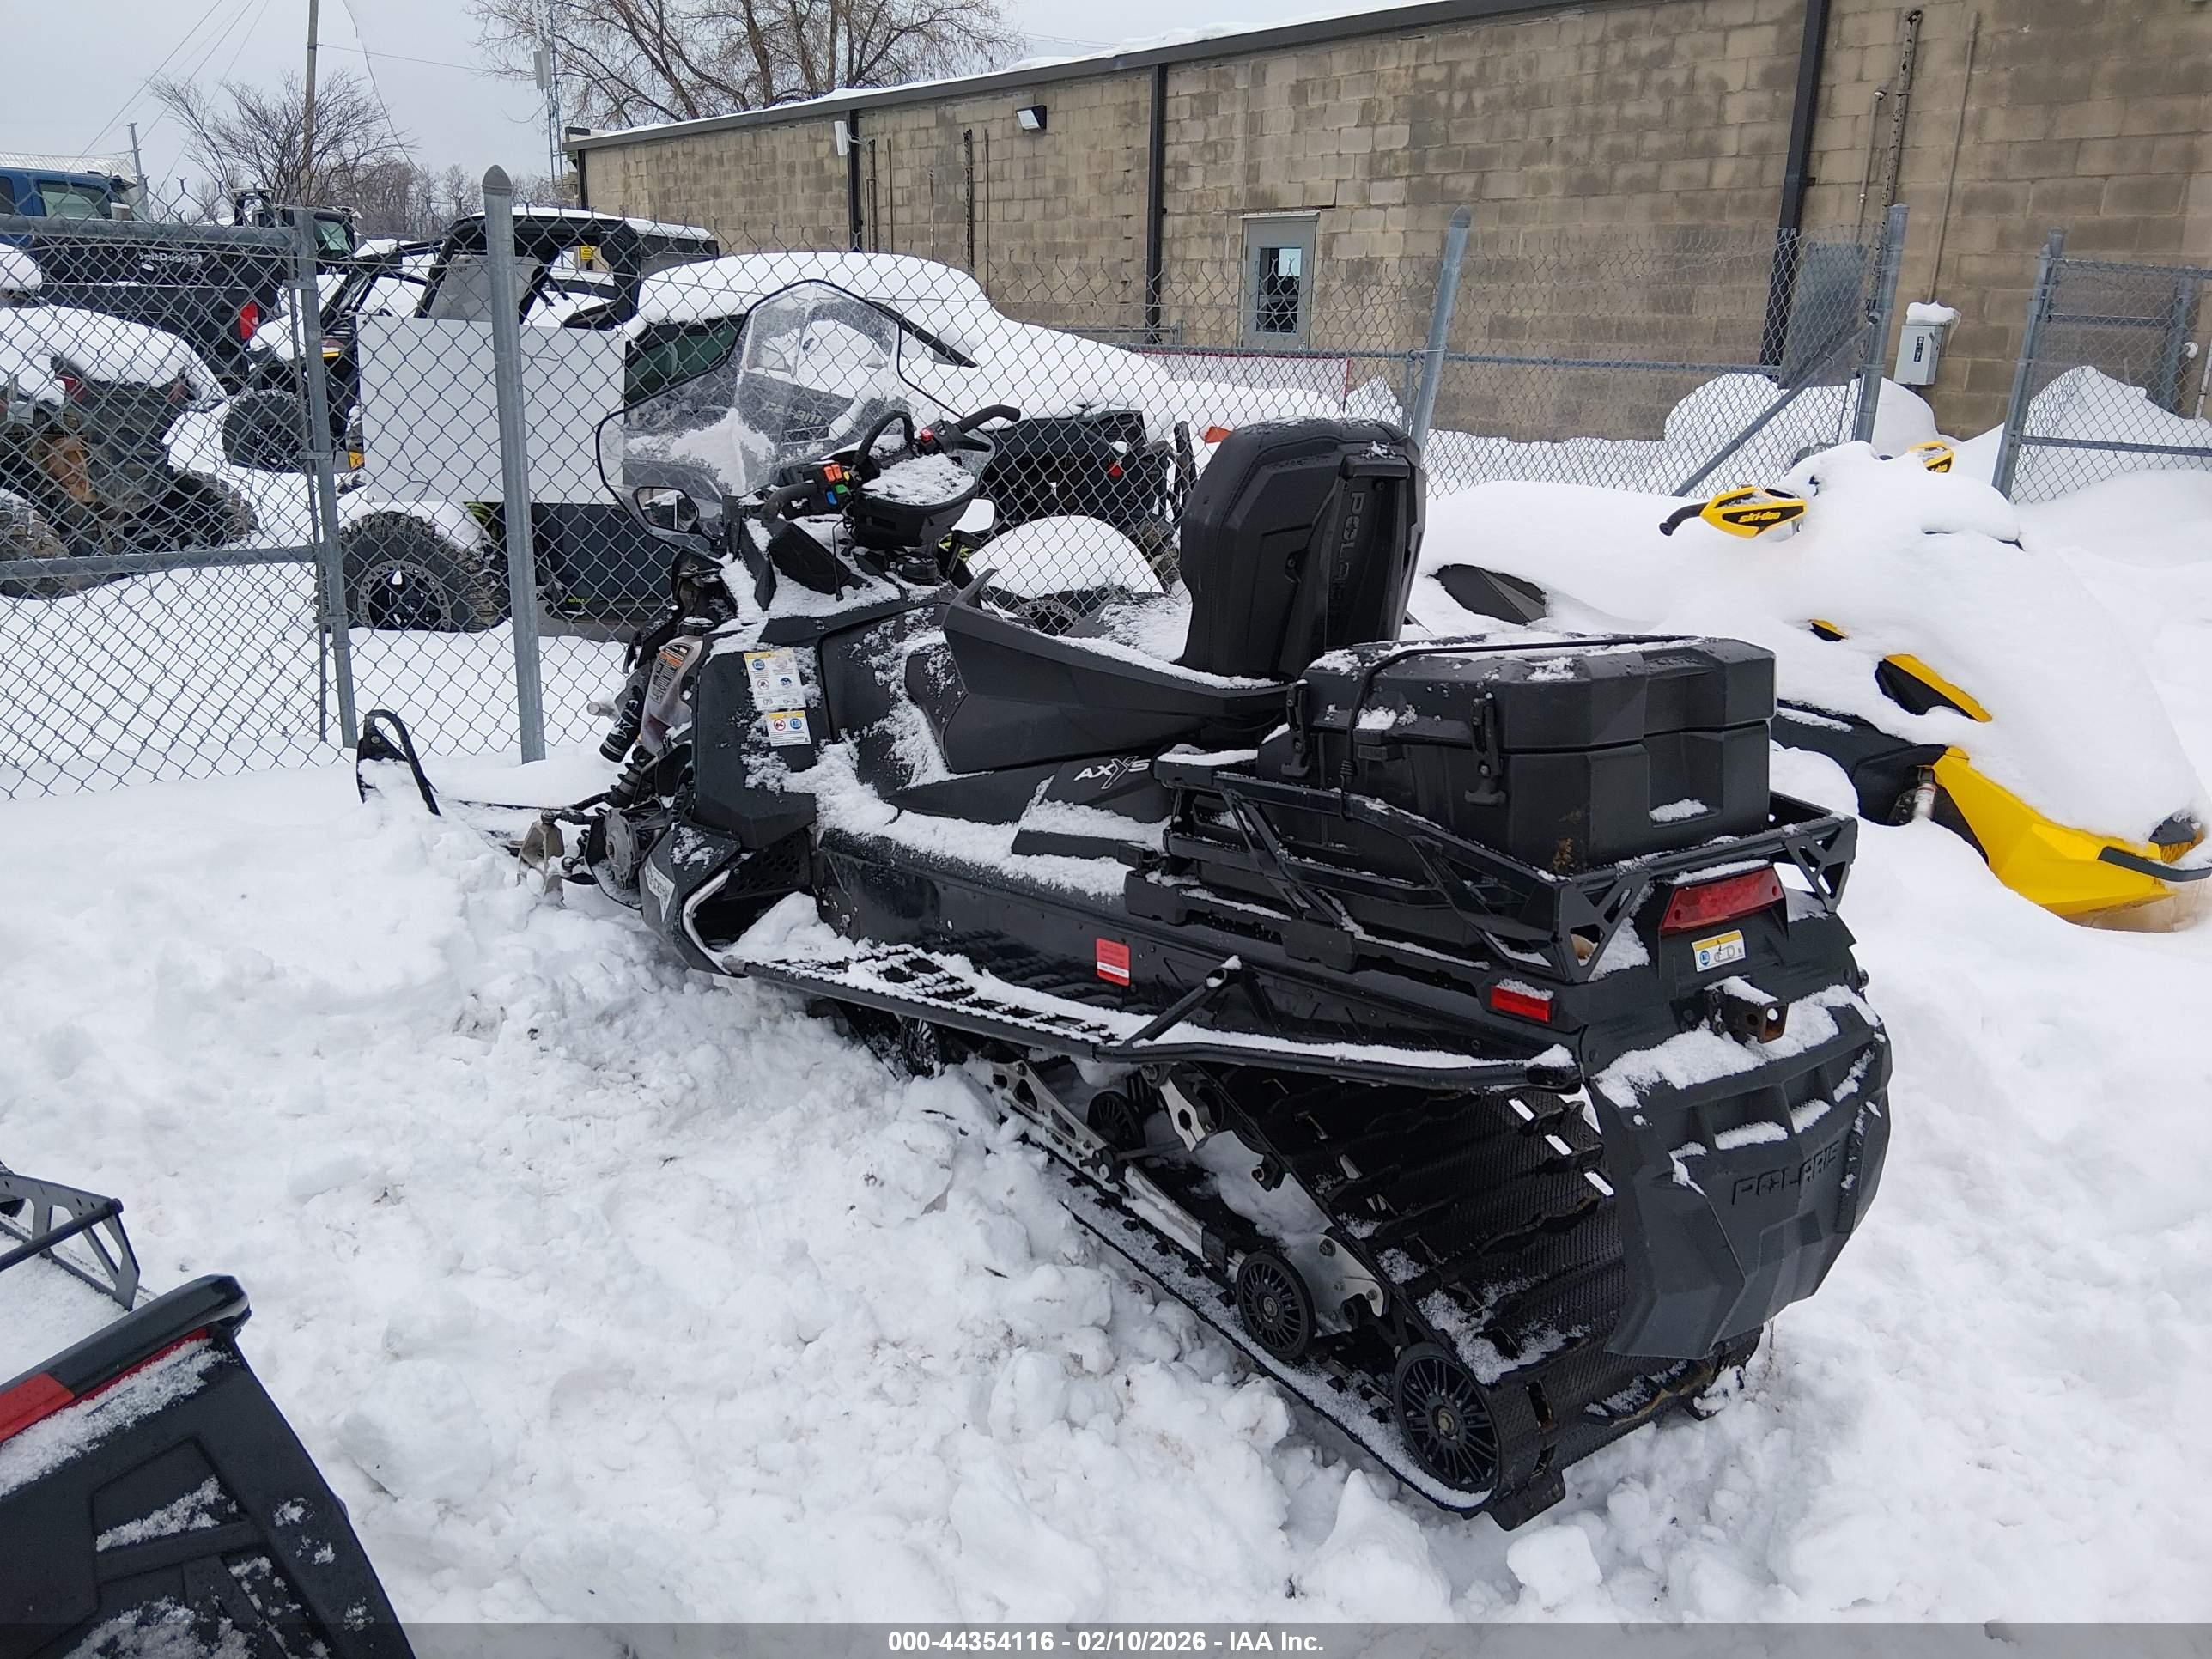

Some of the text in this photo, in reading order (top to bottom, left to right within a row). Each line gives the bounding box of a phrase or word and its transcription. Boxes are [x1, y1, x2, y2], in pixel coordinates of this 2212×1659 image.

[1738, 511, 1782, 523] ski-doo
[1328, 491, 1366, 627] POLAR
[1073, 755, 1152, 790] AXYS
[1731, 1139, 1840, 1206] POLARIS
